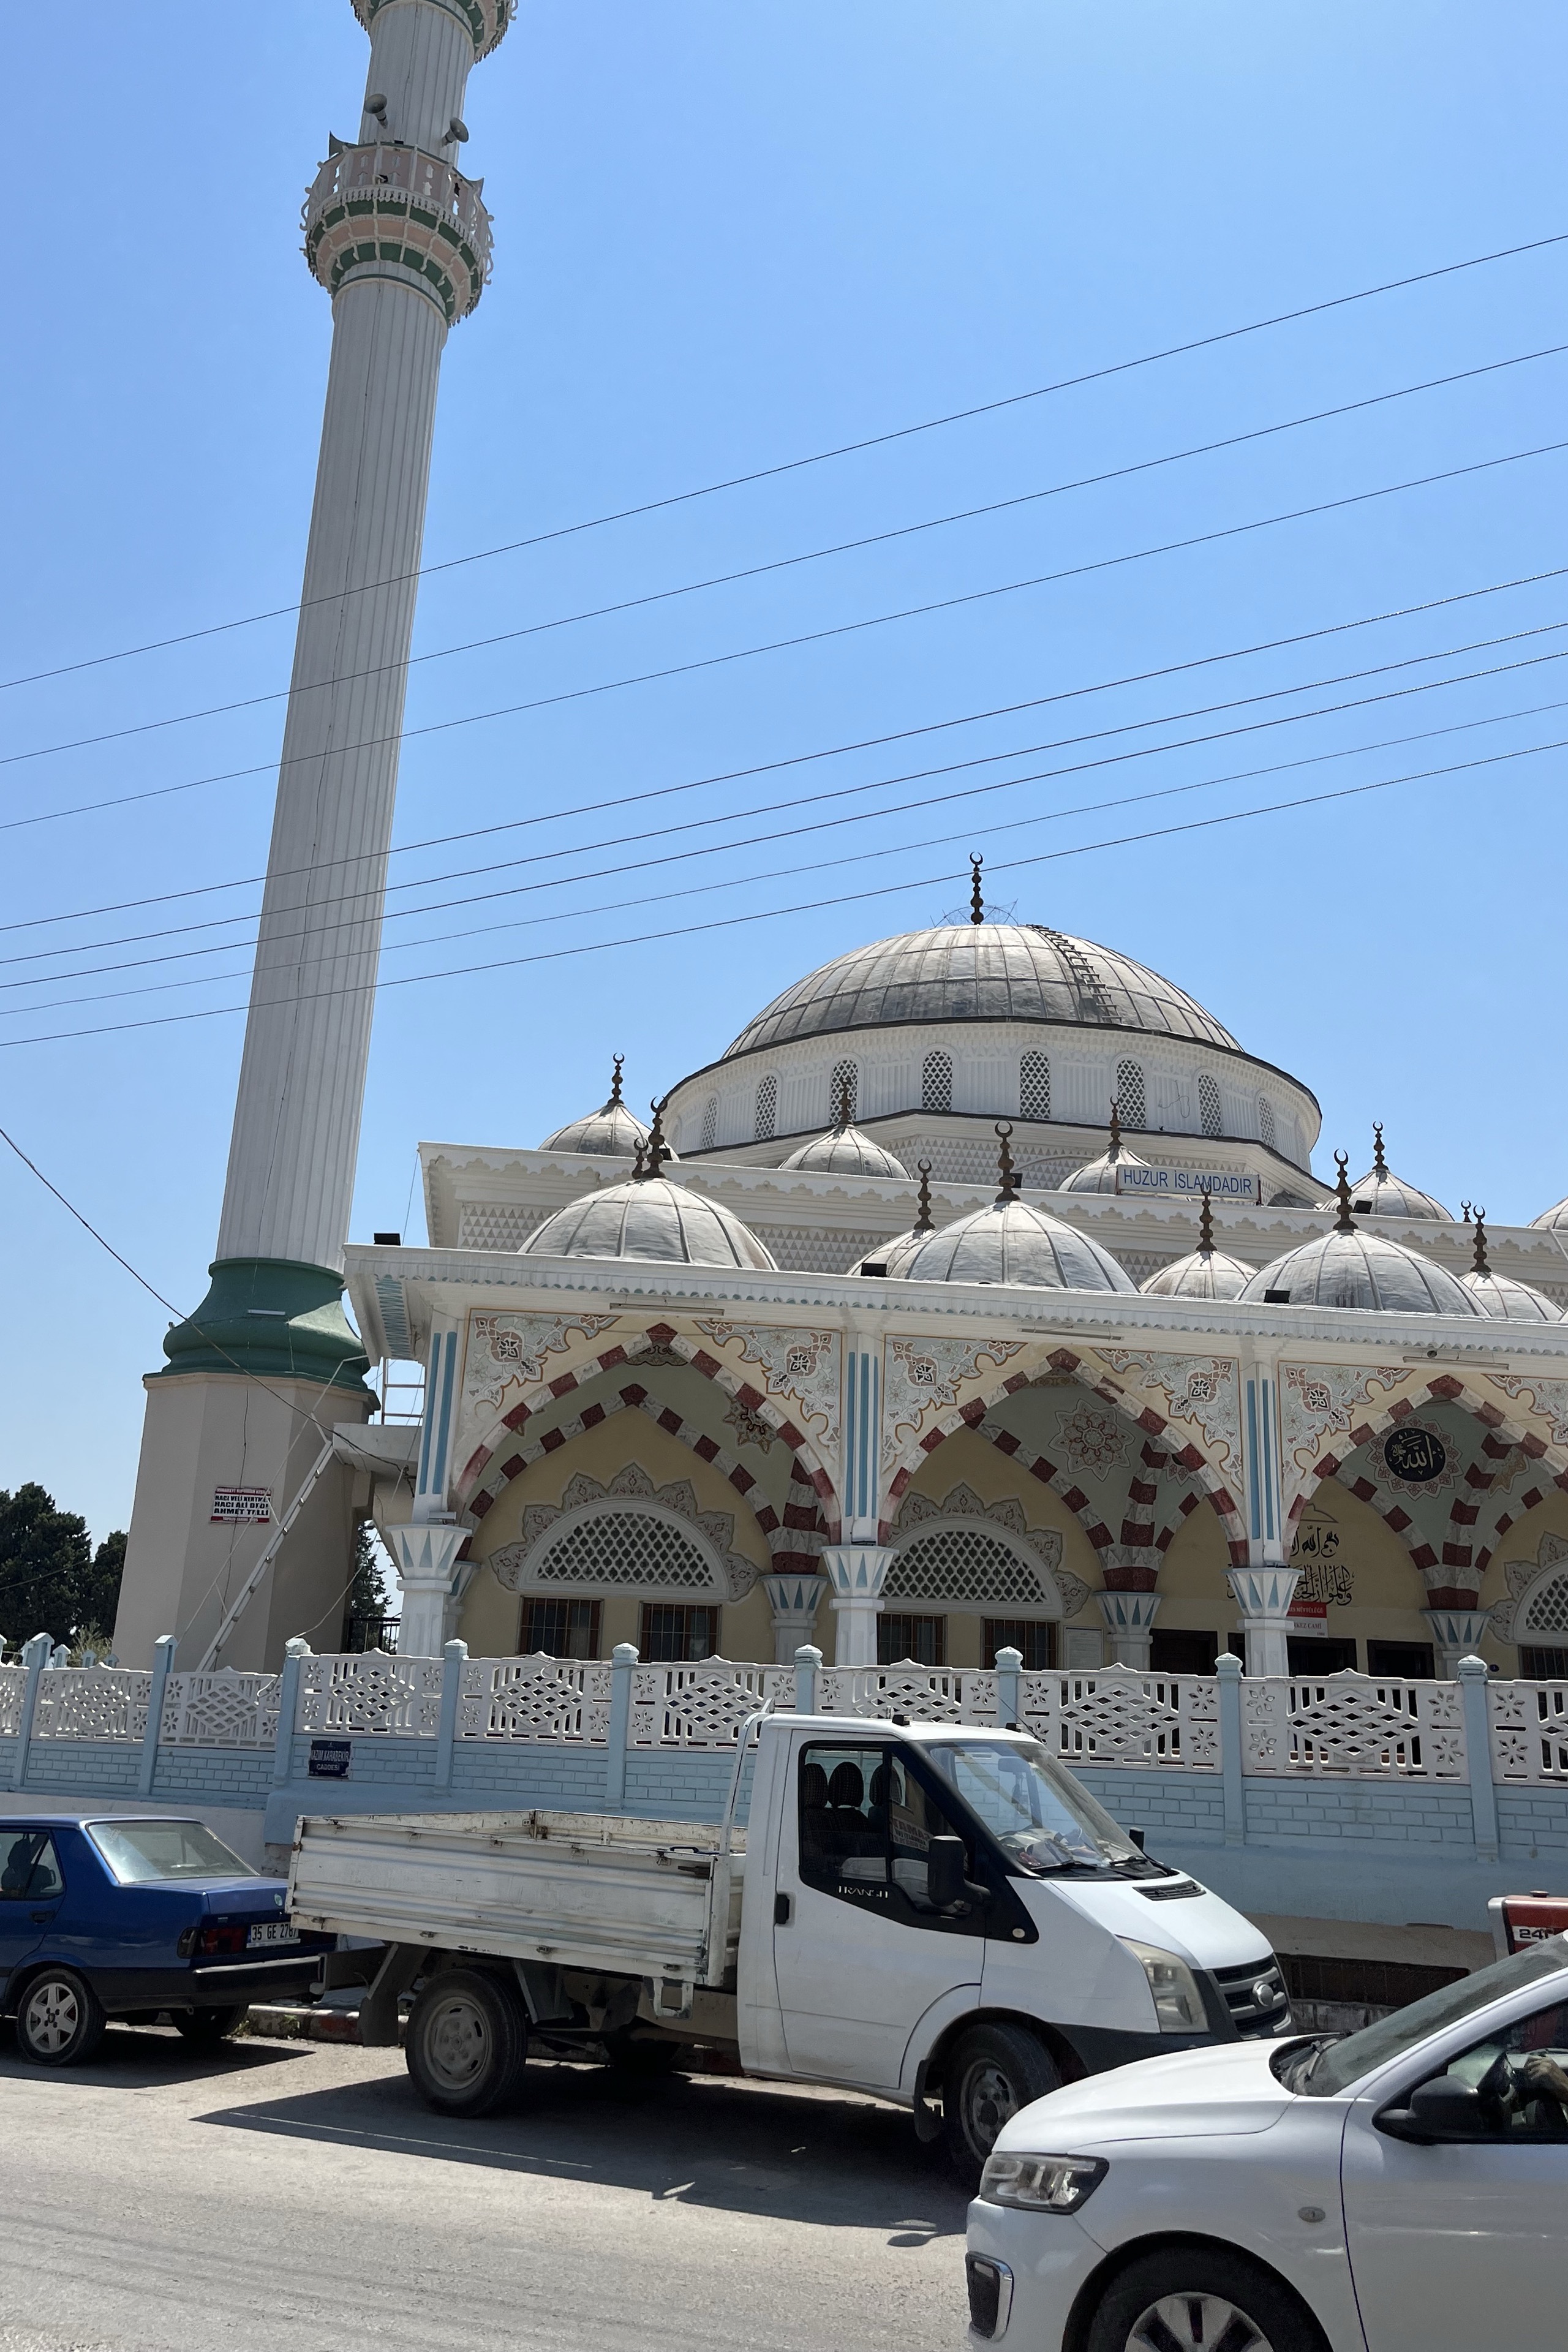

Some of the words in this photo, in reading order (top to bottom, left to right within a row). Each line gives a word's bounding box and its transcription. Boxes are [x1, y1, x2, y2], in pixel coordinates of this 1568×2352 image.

[1123, 1169, 1169, 1188] HUZUR
[252, 1926, 263, 1941] 35
[267, 1924, 277, 1940] GE
